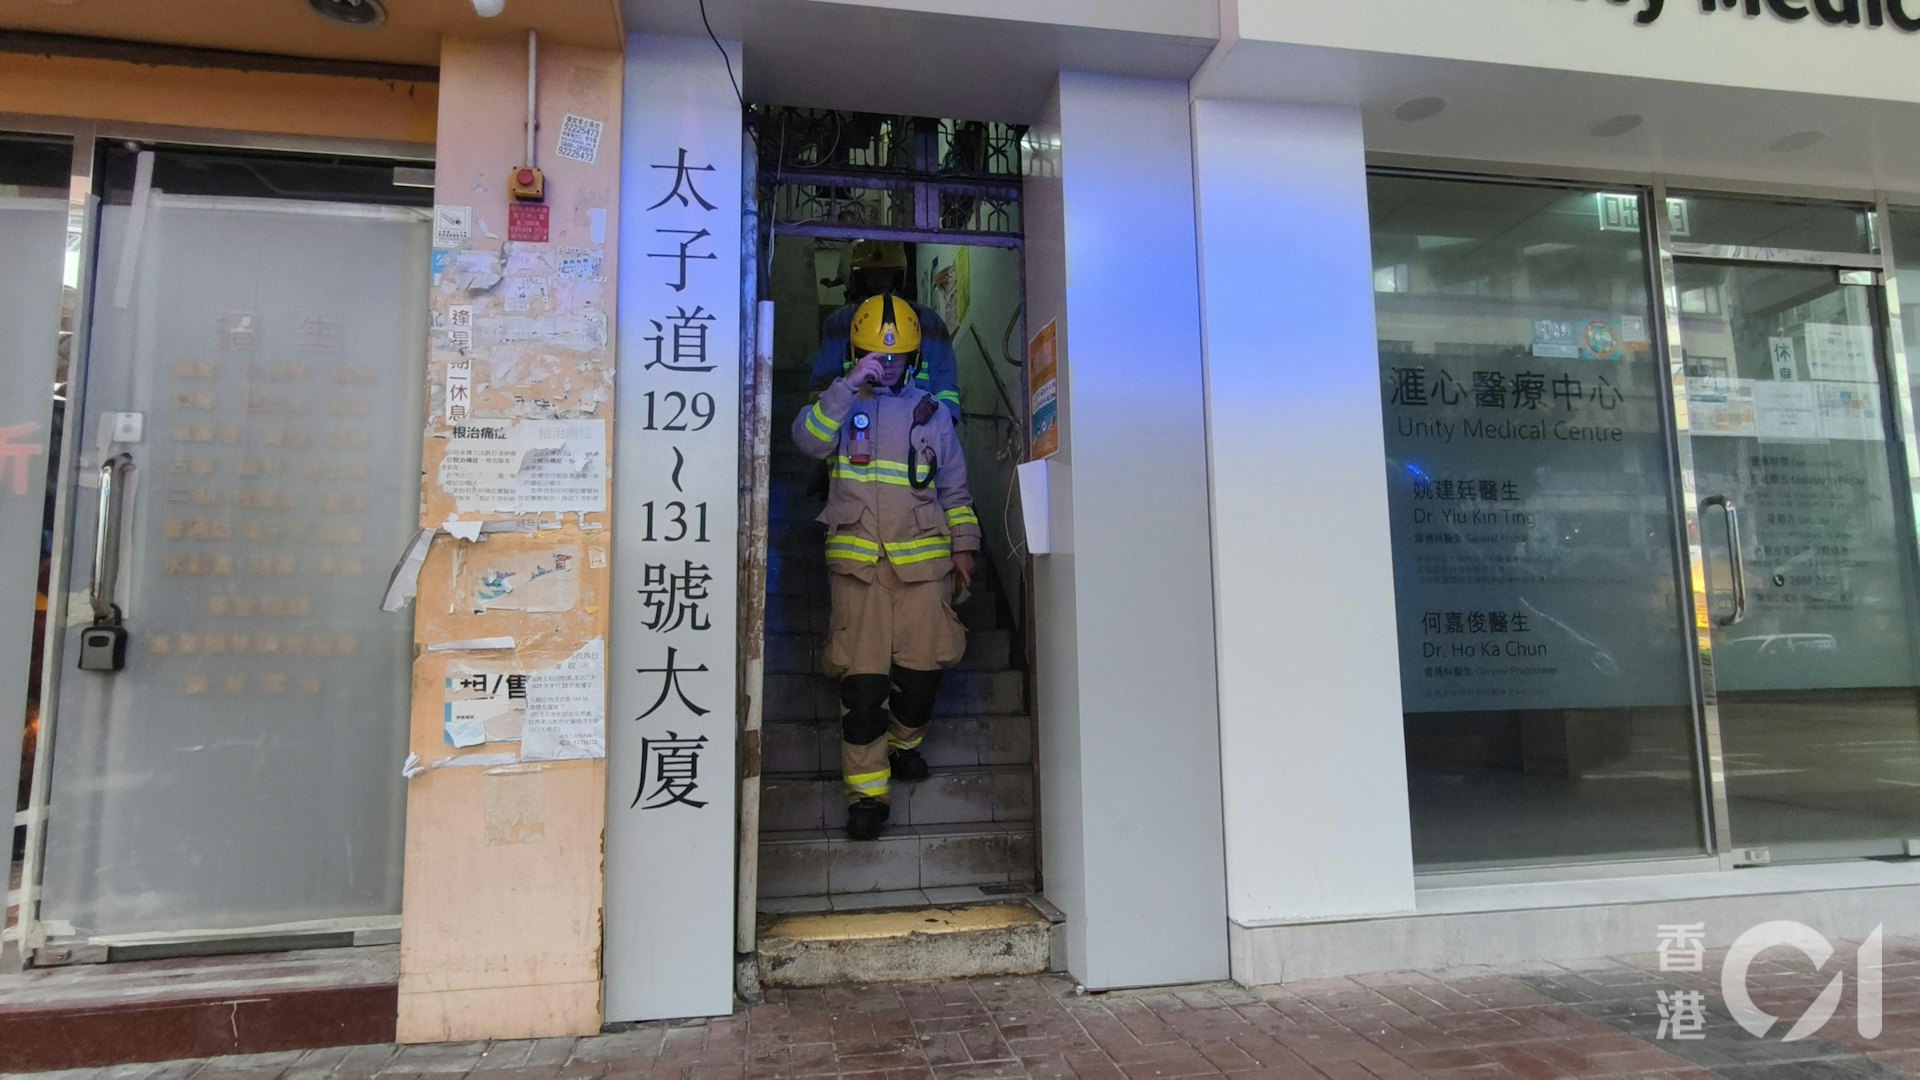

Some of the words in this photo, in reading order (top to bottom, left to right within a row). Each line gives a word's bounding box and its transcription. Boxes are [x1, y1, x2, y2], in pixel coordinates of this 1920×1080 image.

[1399, 416, 1455, 444] Unity
[1463, 418, 1546, 440] Medical
[1554, 421, 1623, 442] Centre
[1413, 479, 1520, 501] 姚建廷醫生
[1442, 508, 1467, 524] Yiu
[1473, 509, 1497, 524] Kin
[1502, 508, 1536, 528] Ting
[1421, 611, 1531, 634] 何嘉俊醫生
[1424, 642, 1446, 658] Dr.
[1452, 642, 1475, 658] Ho
[1481, 642, 1500, 657] Ka
[1506, 641, 1547, 657] Chun
